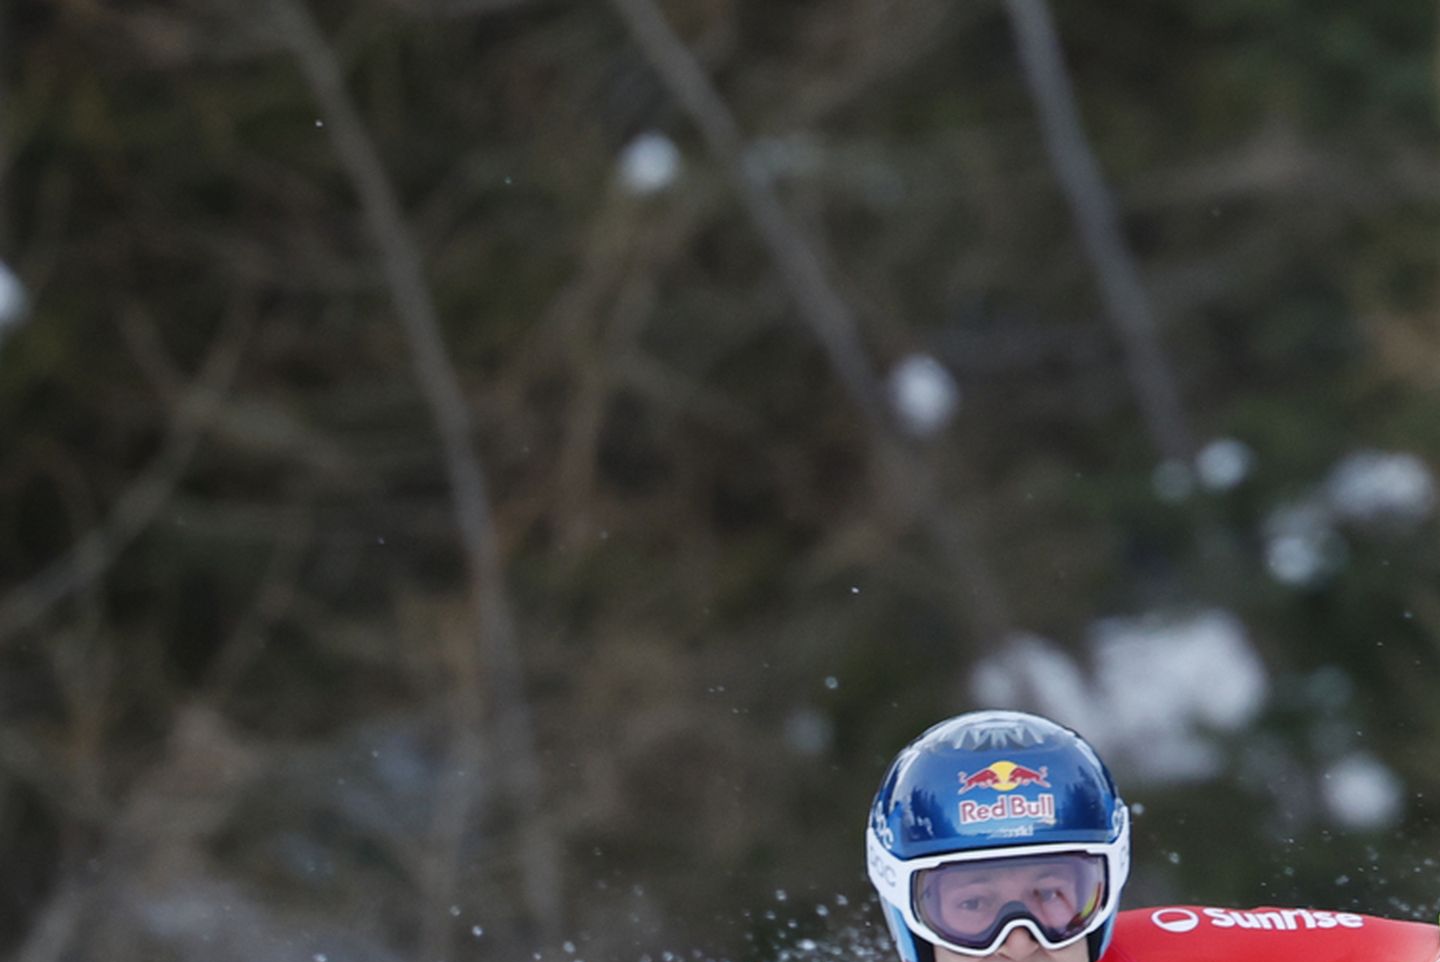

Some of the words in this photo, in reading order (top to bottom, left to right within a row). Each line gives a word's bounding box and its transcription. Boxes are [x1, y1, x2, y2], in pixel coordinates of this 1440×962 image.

[959, 794, 1007, 825] Red
[1009, 793, 1055, 818] Bull
[1202, 907, 1364, 930] Sunrise
